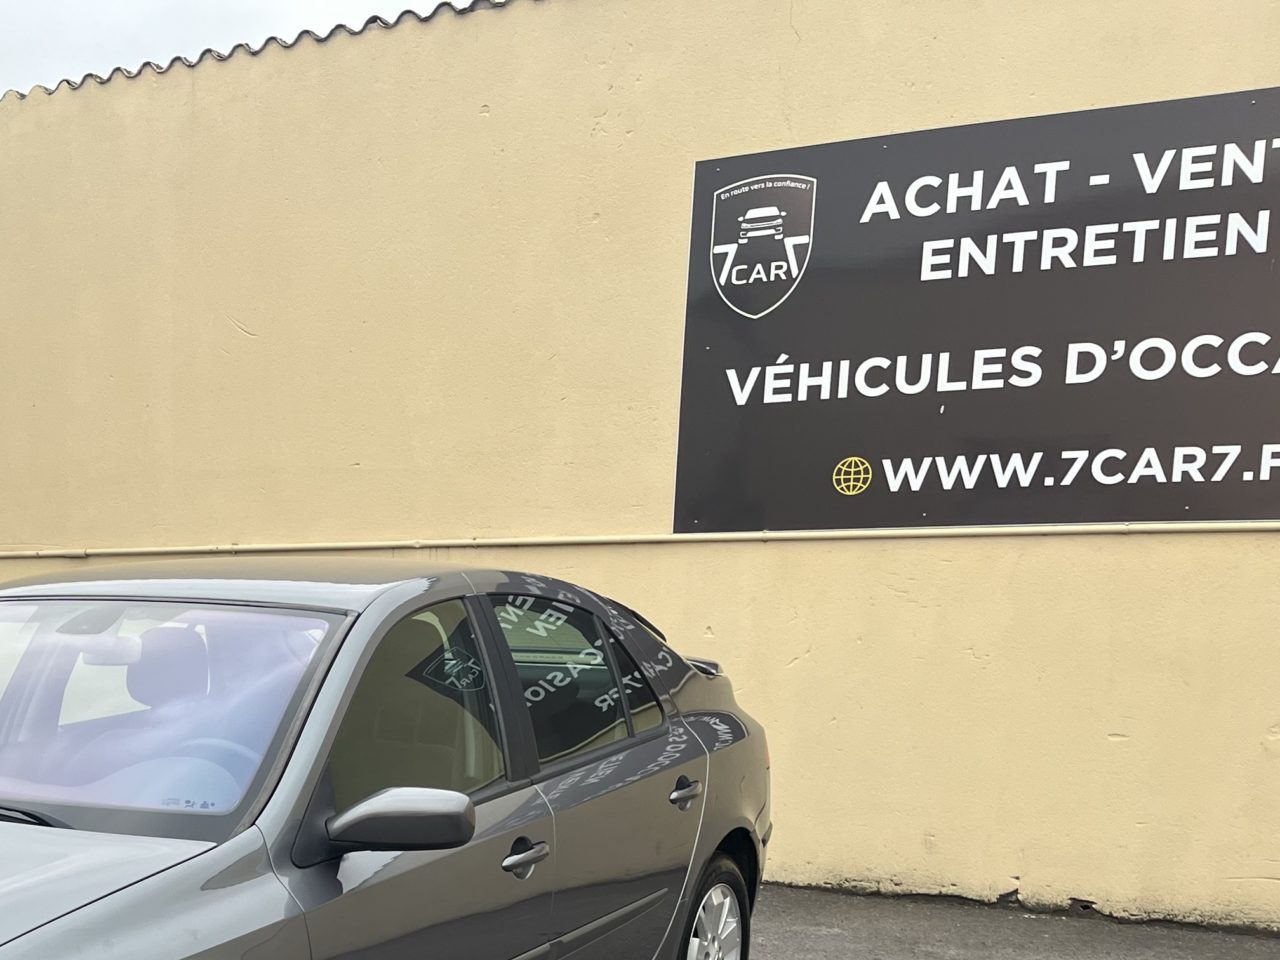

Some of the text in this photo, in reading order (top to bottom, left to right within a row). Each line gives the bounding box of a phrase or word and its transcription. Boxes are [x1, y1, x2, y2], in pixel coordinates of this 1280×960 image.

[730, 186, 750, 196] route
[750, 181, 765, 191] vers
[860, 161, 1071, 223] ACHAT
[920, 210, 1270, 281] ENTRETIEN
[726, 345, 1043, 406] VÉHICULES
